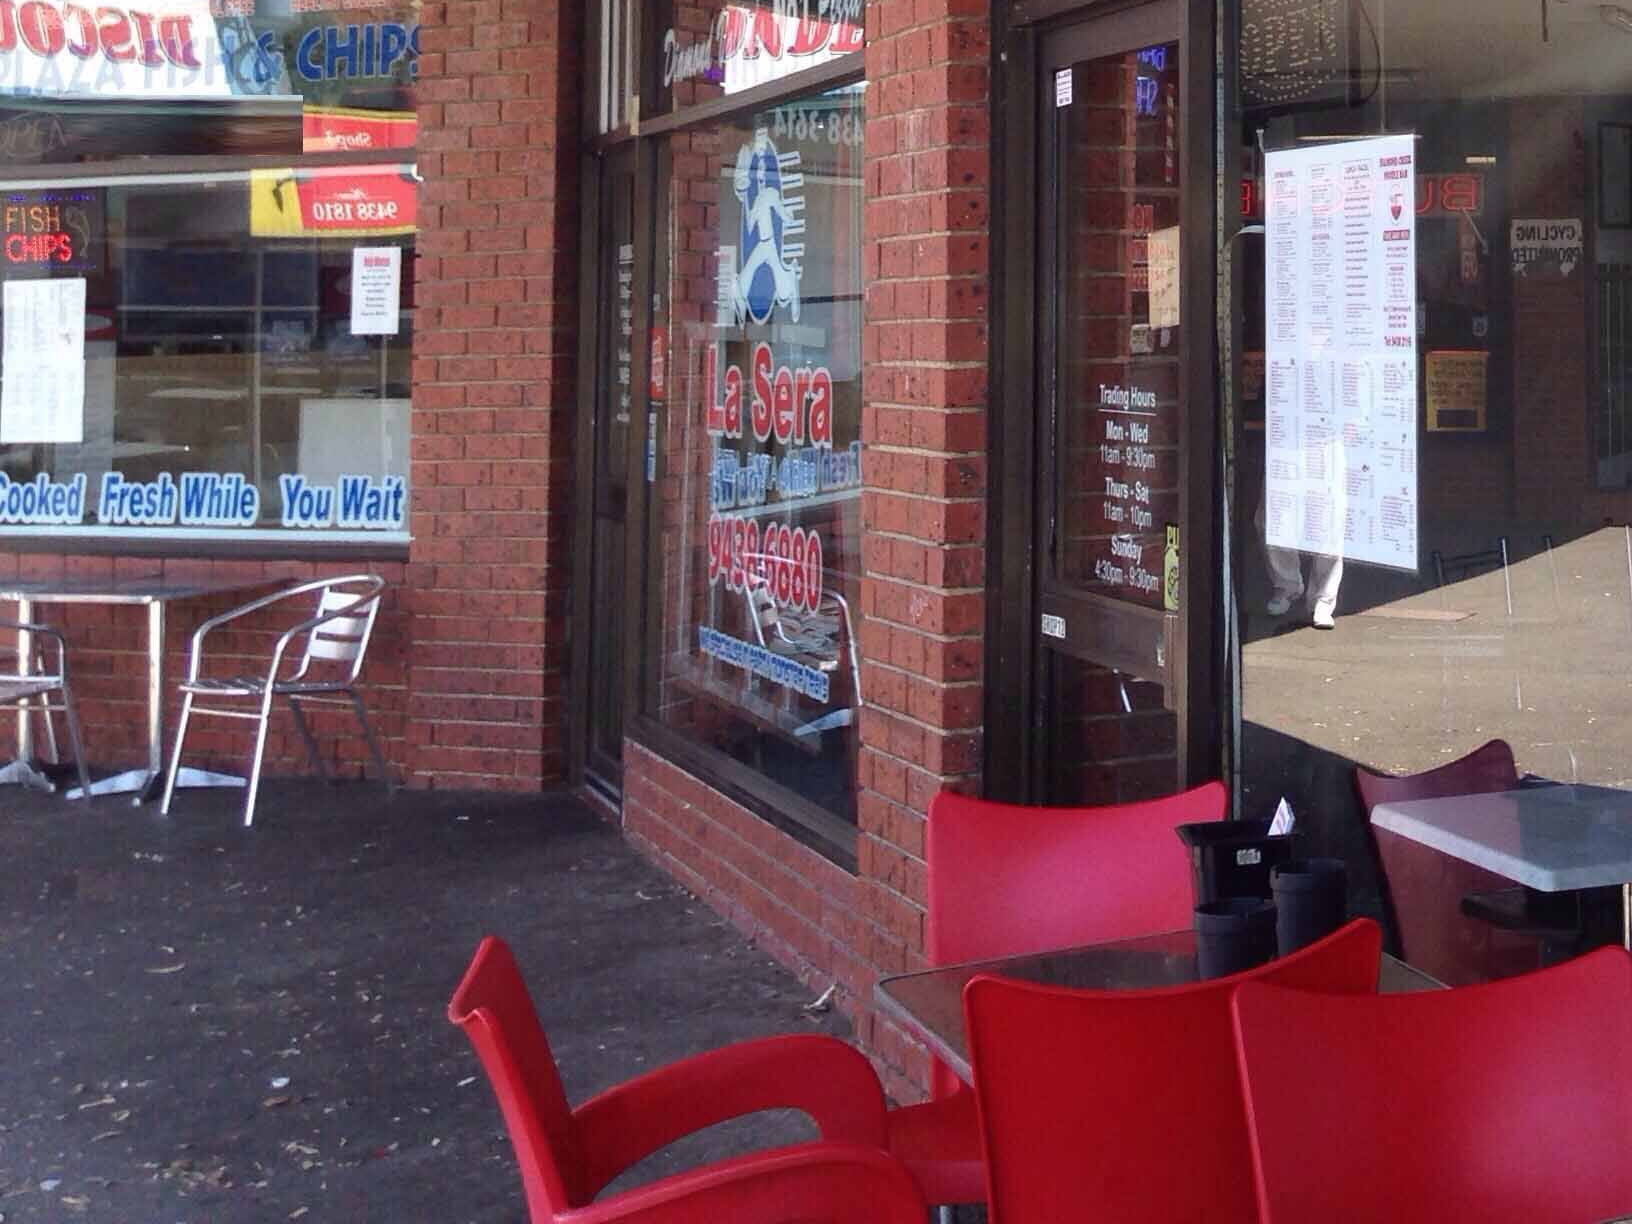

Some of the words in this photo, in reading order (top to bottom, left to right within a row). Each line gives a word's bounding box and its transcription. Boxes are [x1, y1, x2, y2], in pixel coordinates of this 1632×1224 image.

[5, 206, 60, 233] FISH
[4, 235, 73, 264] CHIPS
[706, 342, 743, 439] La
[751, 340, 833, 449] Sera
[1099, 384, 1130, 411] Trading
[1130, 386, 1156, 409] Hours
[1106, 420, 1124, 441] Mon
[1130, 422, 1149, 443] Wed
[103, 474, 176, 519] Fresh
[185, 474, 258, 521] While
[283, 476, 332, 522] You
[339, 478, 403, 522] Wait
[1105, 477, 1129, 500] Thurs
[1135, 481, 1150, 504] Sat
[1130, 505, 1152, 531] 10pm
[1111, 535, 1143, 565] Sunday
